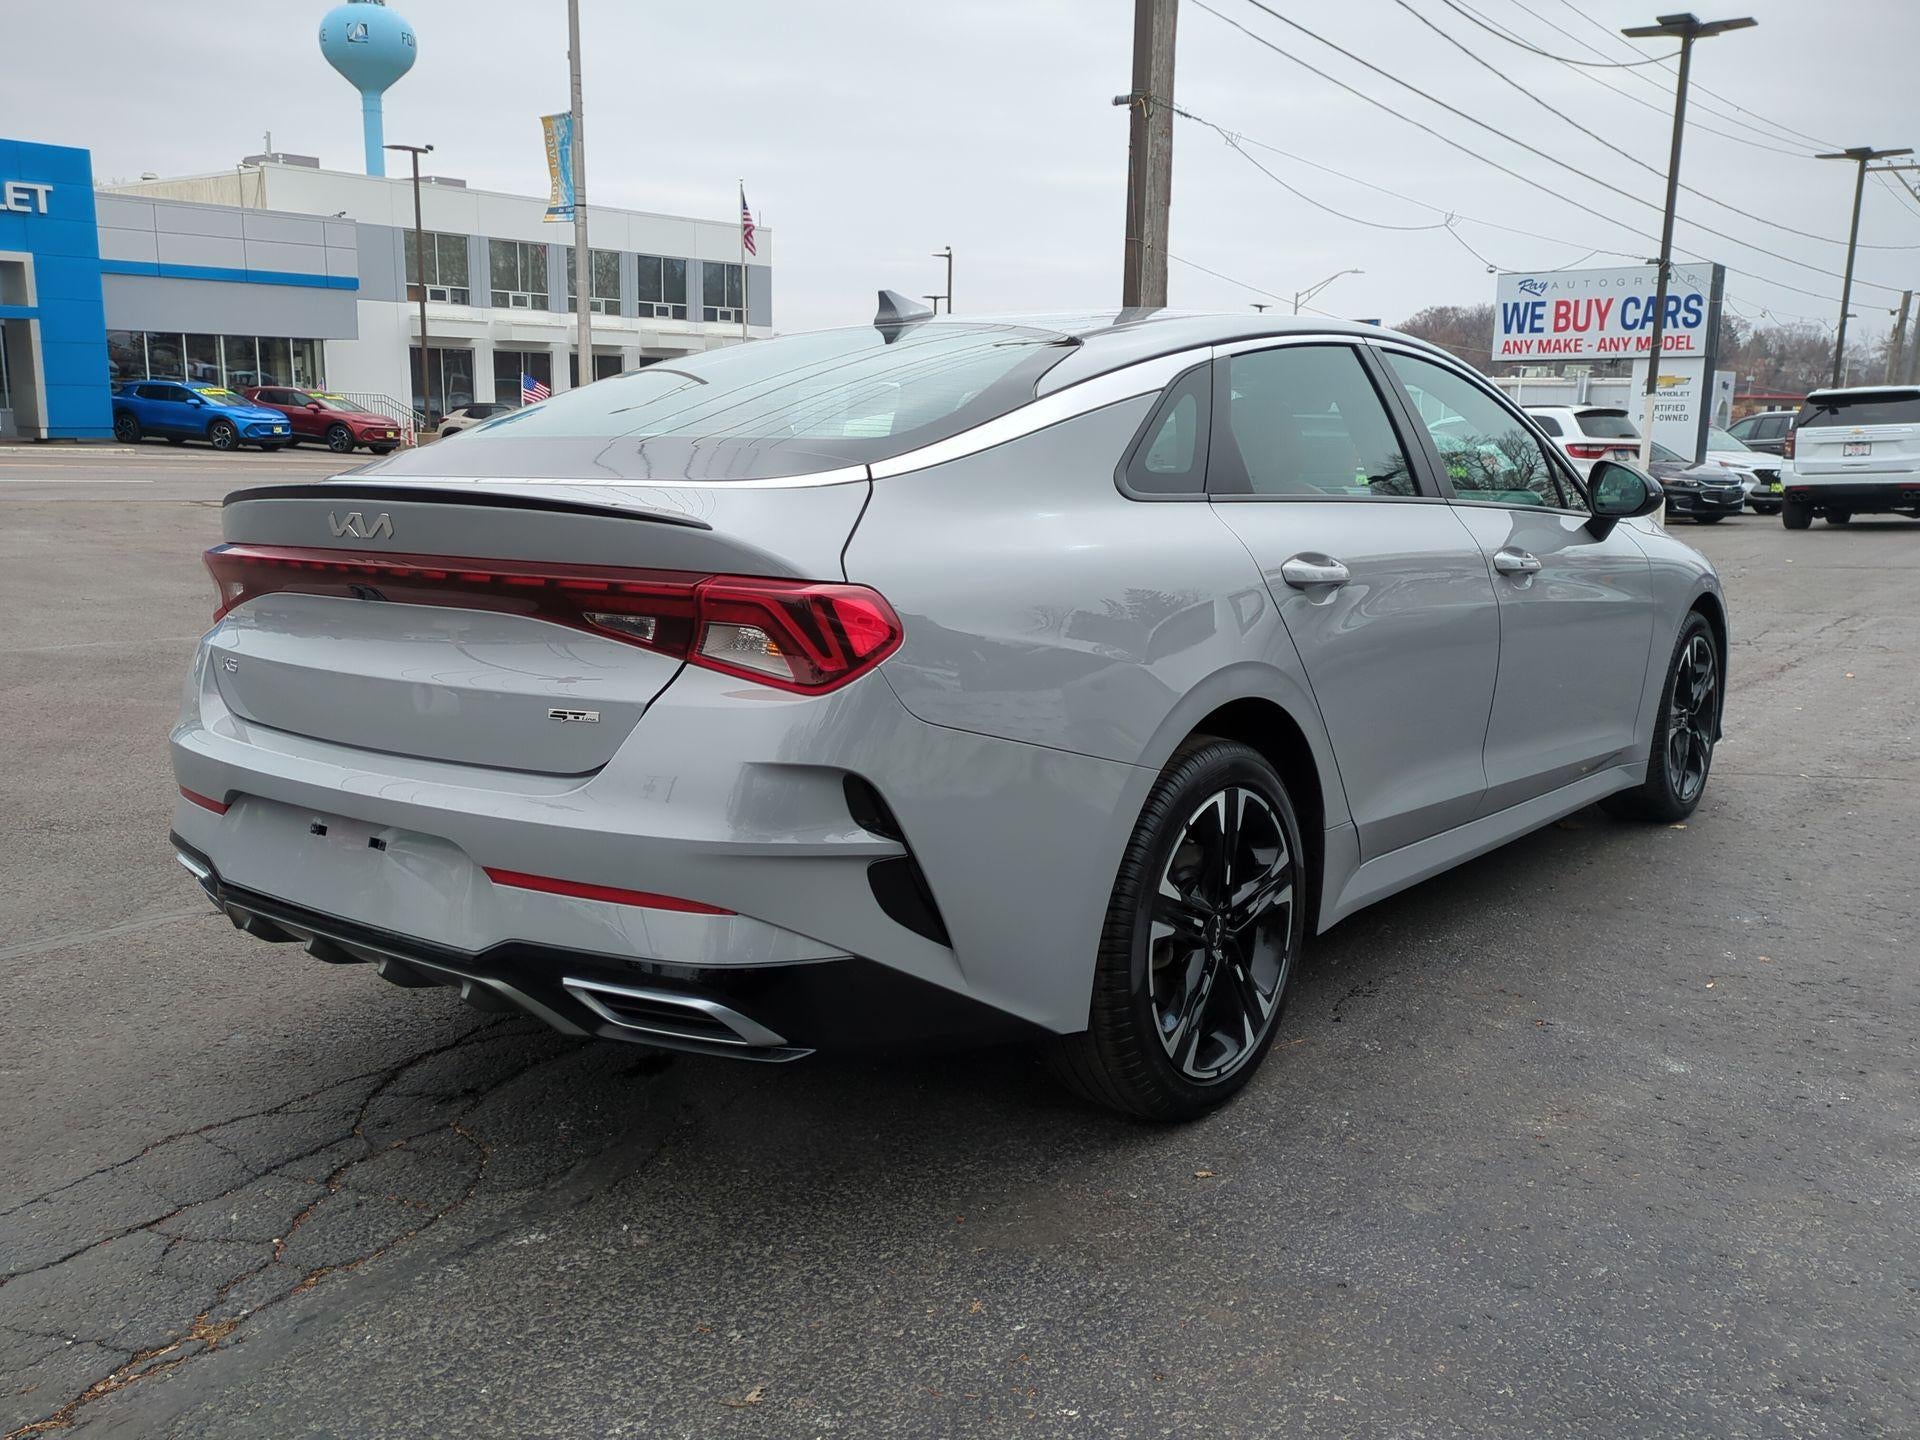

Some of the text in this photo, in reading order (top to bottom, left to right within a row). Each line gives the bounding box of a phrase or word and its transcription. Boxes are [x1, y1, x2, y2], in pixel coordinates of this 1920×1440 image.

[545, 127, 557, 169] LAKE
[1518, 278, 1549, 297] Ray
[1502, 293, 1704, 335] WE BUY CARS
[1501, 338, 1535, 355] ANY
[1537, 337, 1584, 354] MAKE
[1597, 336, 1632, 352] ANY
[1635, 335, 1695, 352] MDEL
[1639, 414, 1689, 422] P-OWNED
[1654, 404, 1686, 412] RTIFIED
[328, 511, 395, 540] KIA
